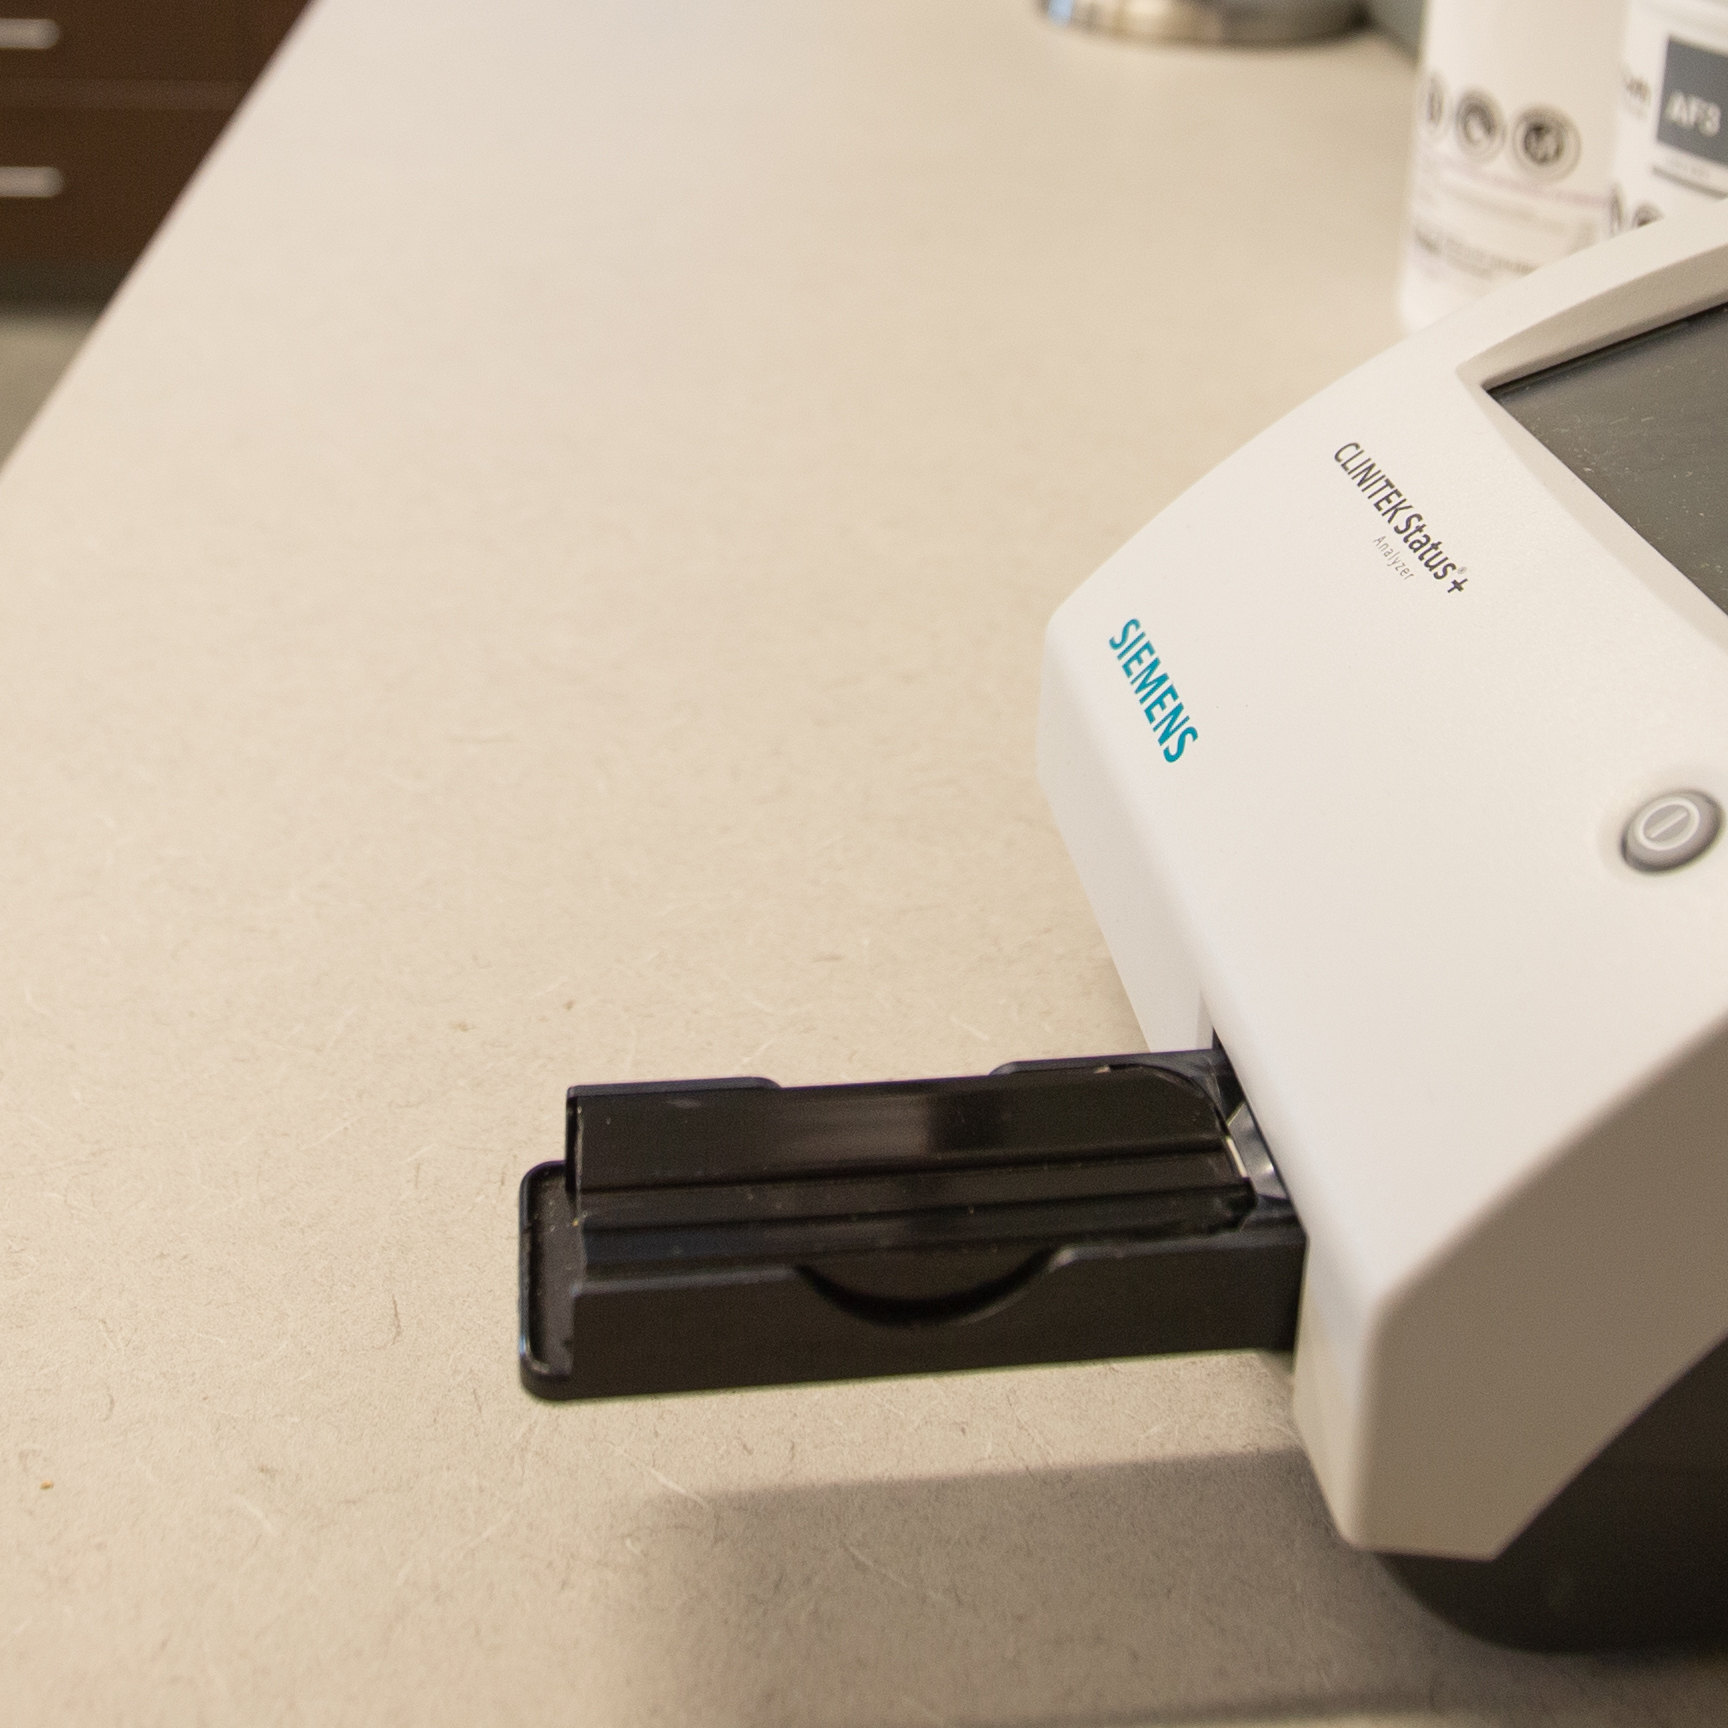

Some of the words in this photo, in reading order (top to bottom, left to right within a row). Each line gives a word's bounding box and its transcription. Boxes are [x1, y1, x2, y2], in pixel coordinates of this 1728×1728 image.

[1333, 441, 1415, 525] CLINITEK
[1372, 534, 1416, 581] Analyzer
[1108, 617, 1199, 764] SIEMENS
